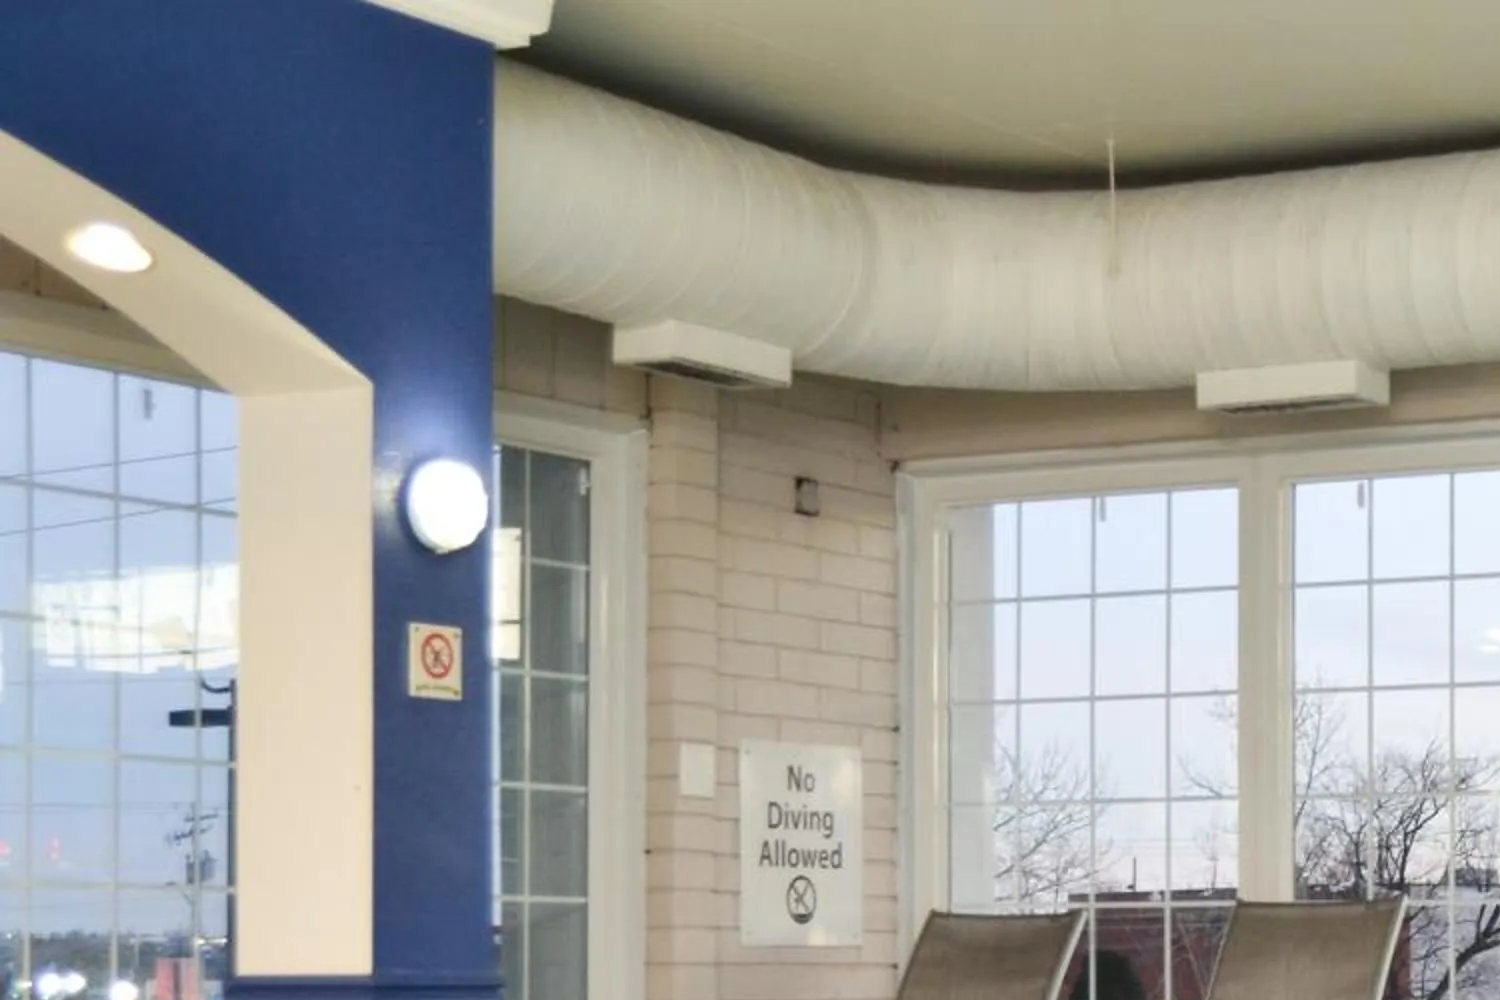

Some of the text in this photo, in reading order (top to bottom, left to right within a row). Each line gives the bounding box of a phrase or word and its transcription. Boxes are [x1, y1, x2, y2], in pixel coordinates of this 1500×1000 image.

[786, 765, 816, 793] No
[767, 801, 834, 839] Diving
[758, 840, 843, 869] Allowed
